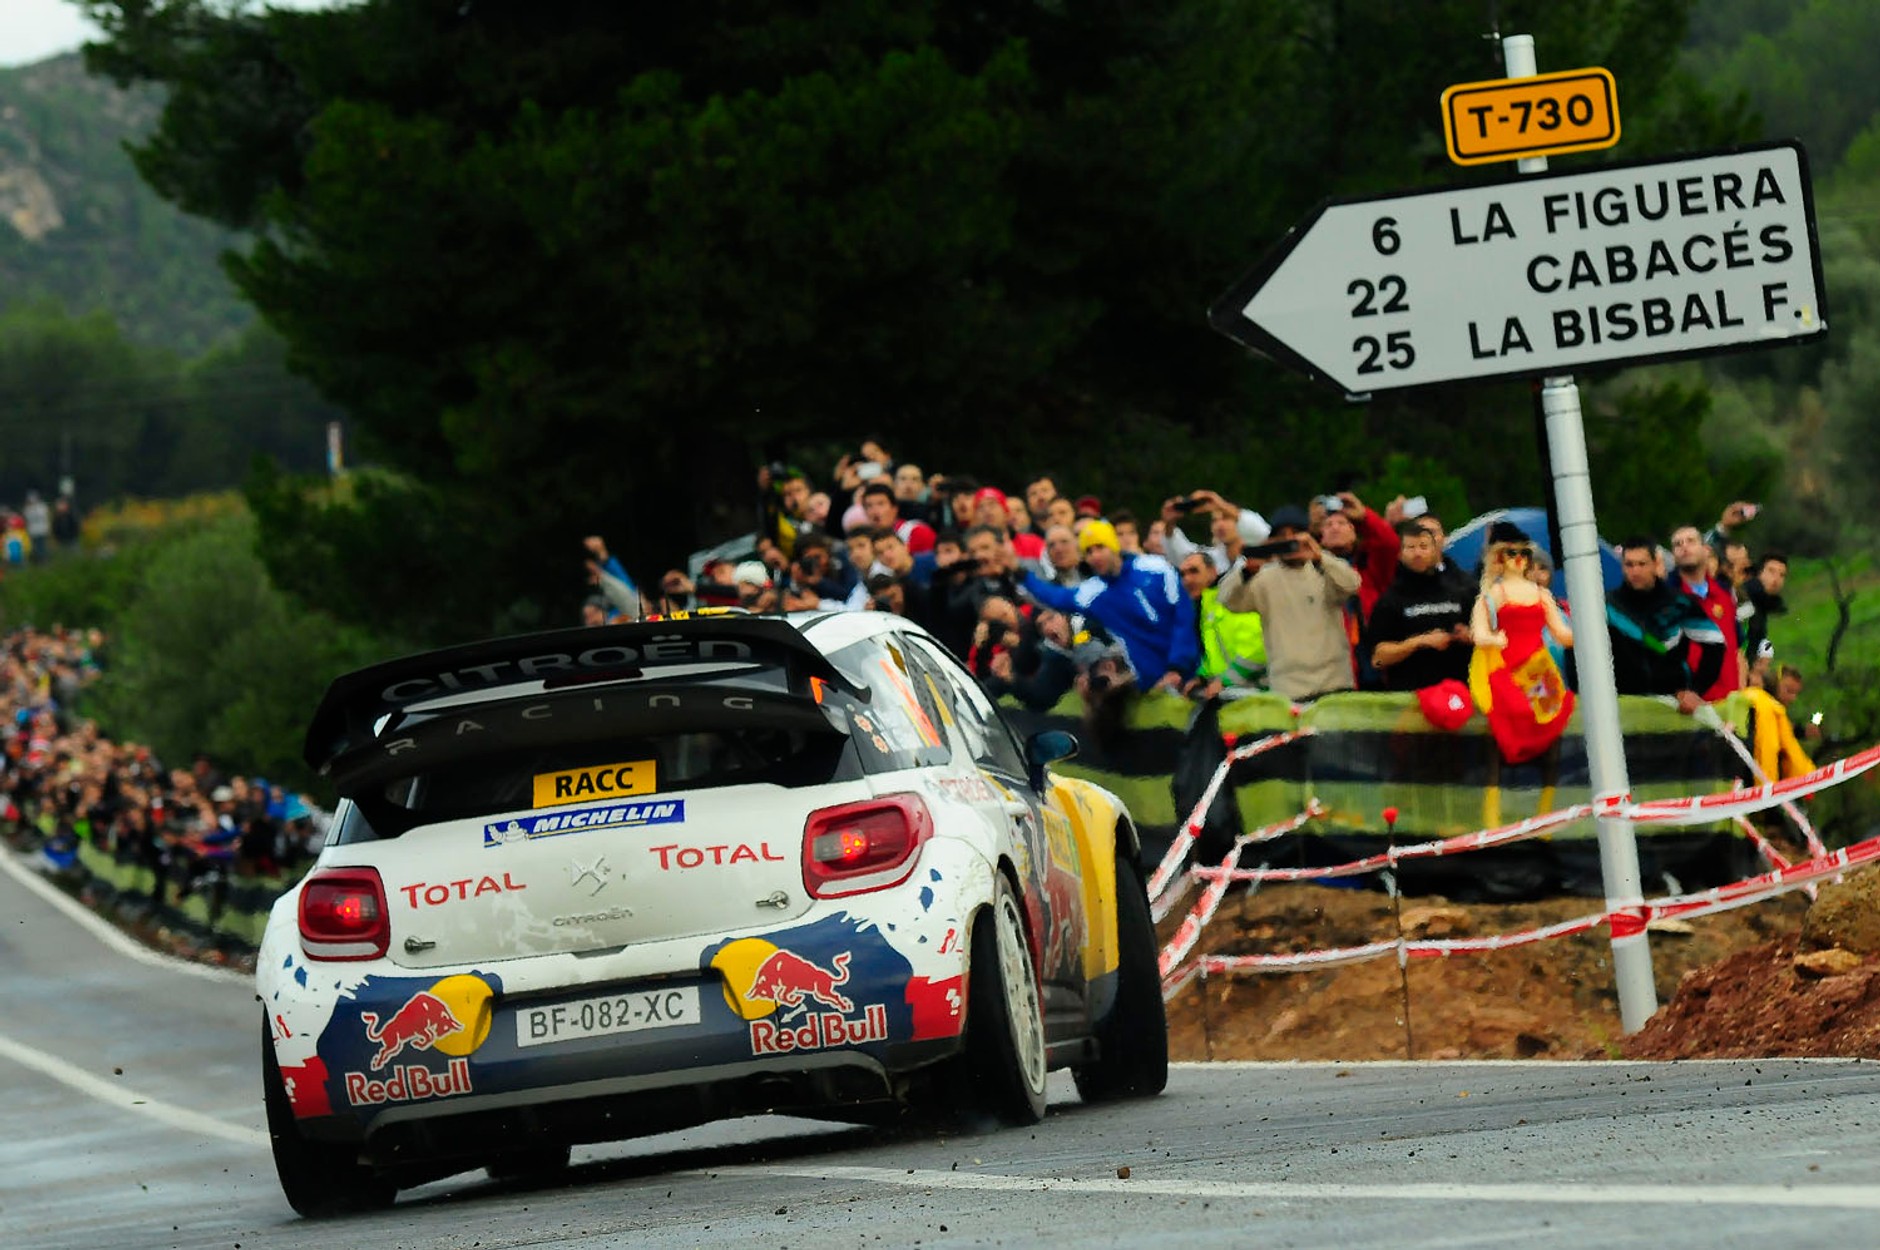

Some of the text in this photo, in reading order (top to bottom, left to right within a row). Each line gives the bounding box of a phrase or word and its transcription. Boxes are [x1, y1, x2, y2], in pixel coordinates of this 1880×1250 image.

[1468, 93, 1595, 139] T-730
[1371, 167, 1786, 256] 6 LA FIGUERA
[1346, 221, 1794, 318] 22 CABACÉS
[1352, 282, 1804, 375] 25 LA BISBAL F.
[381, 634, 751, 700] CITROËN
[554, 766, 634, 799] RACC
[533, 803, 677, 833] MICHELIN
[650, 842, 785, 870] TOTAL
[401, 872, 526, 909] TOTAL
[530, 991, 684, 1039] BF-082-XC
